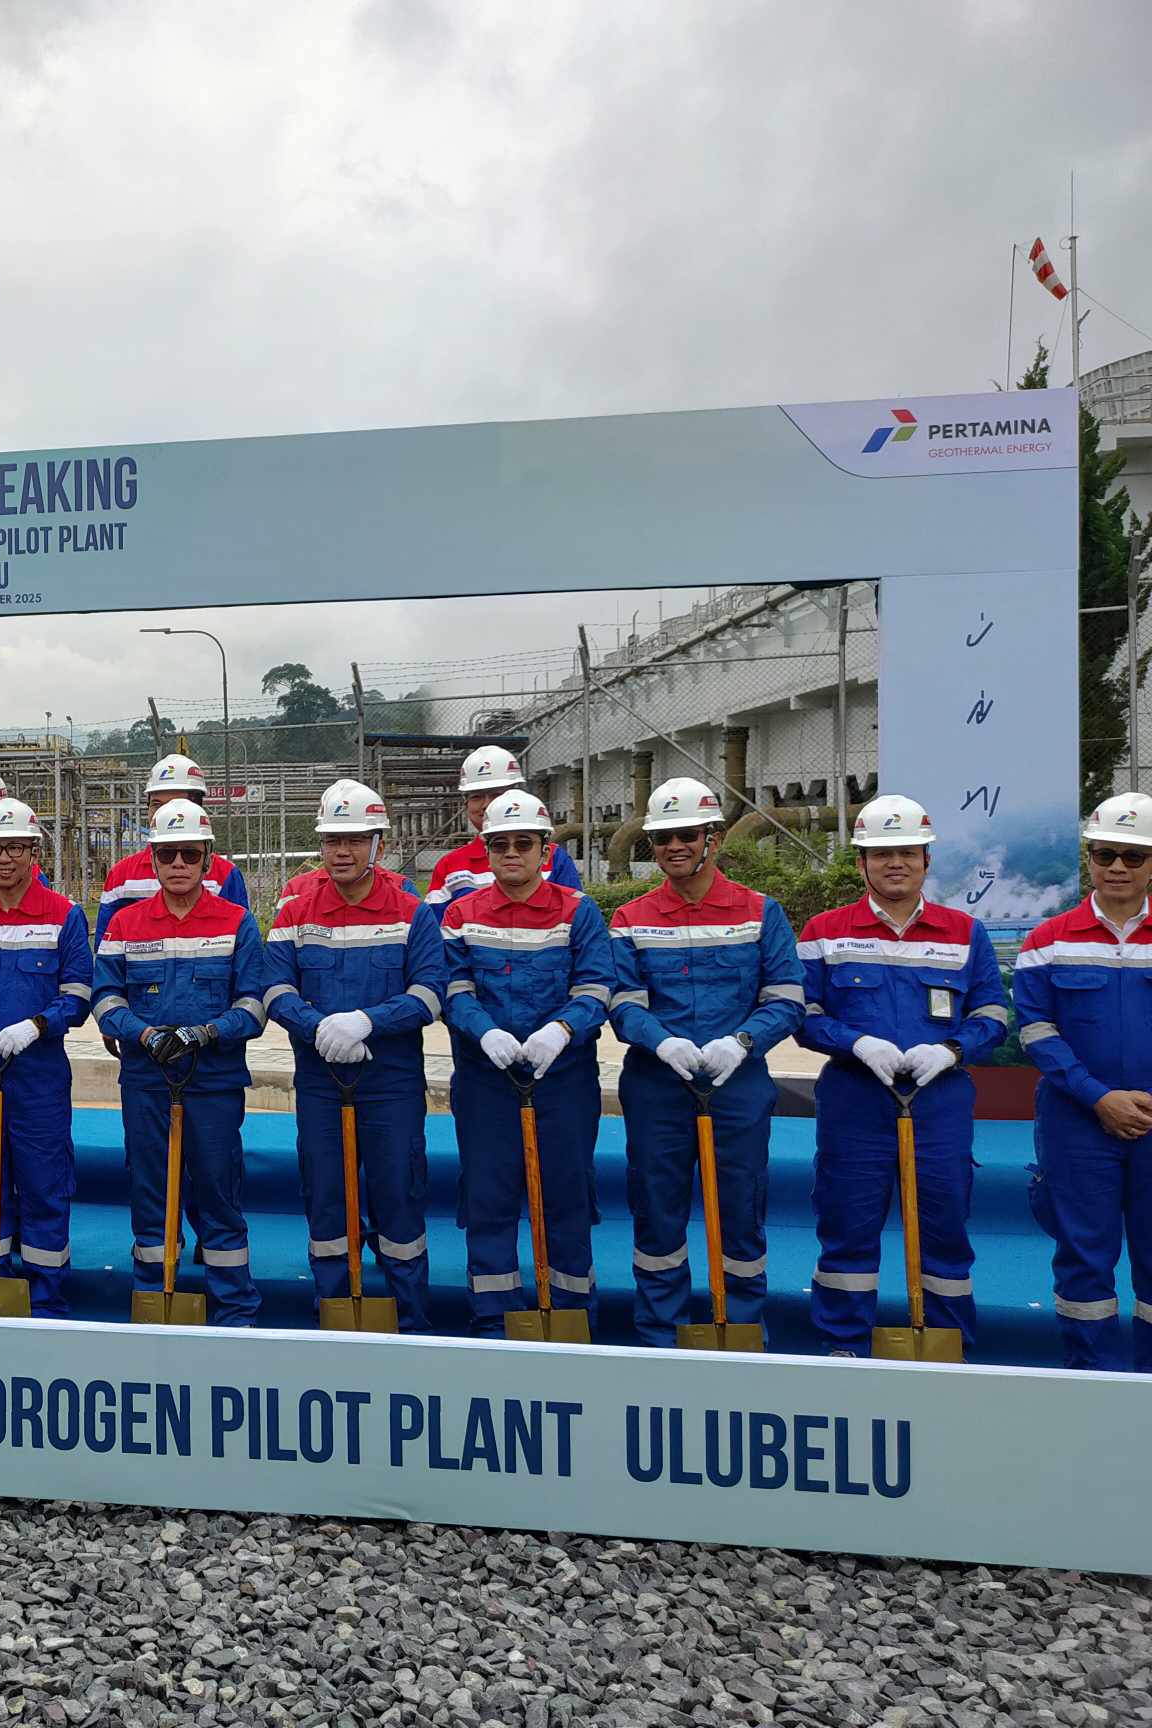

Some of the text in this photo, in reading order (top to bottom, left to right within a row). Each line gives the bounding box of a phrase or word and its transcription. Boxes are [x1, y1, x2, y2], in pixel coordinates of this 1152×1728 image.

[928, 418, 1052, 440] PERTAMINA
[928, 442, 1053, 458] GEOTHERMAL ENERGY
[59, 522, 128, 553] PLANT
[15, 593, 43, 604] 2025
[211, 1385, 371, 1464] PILOT
[389, 1392, 583, 1477] PLANT
[626, 1405, 911, 1498] ULUBELU
